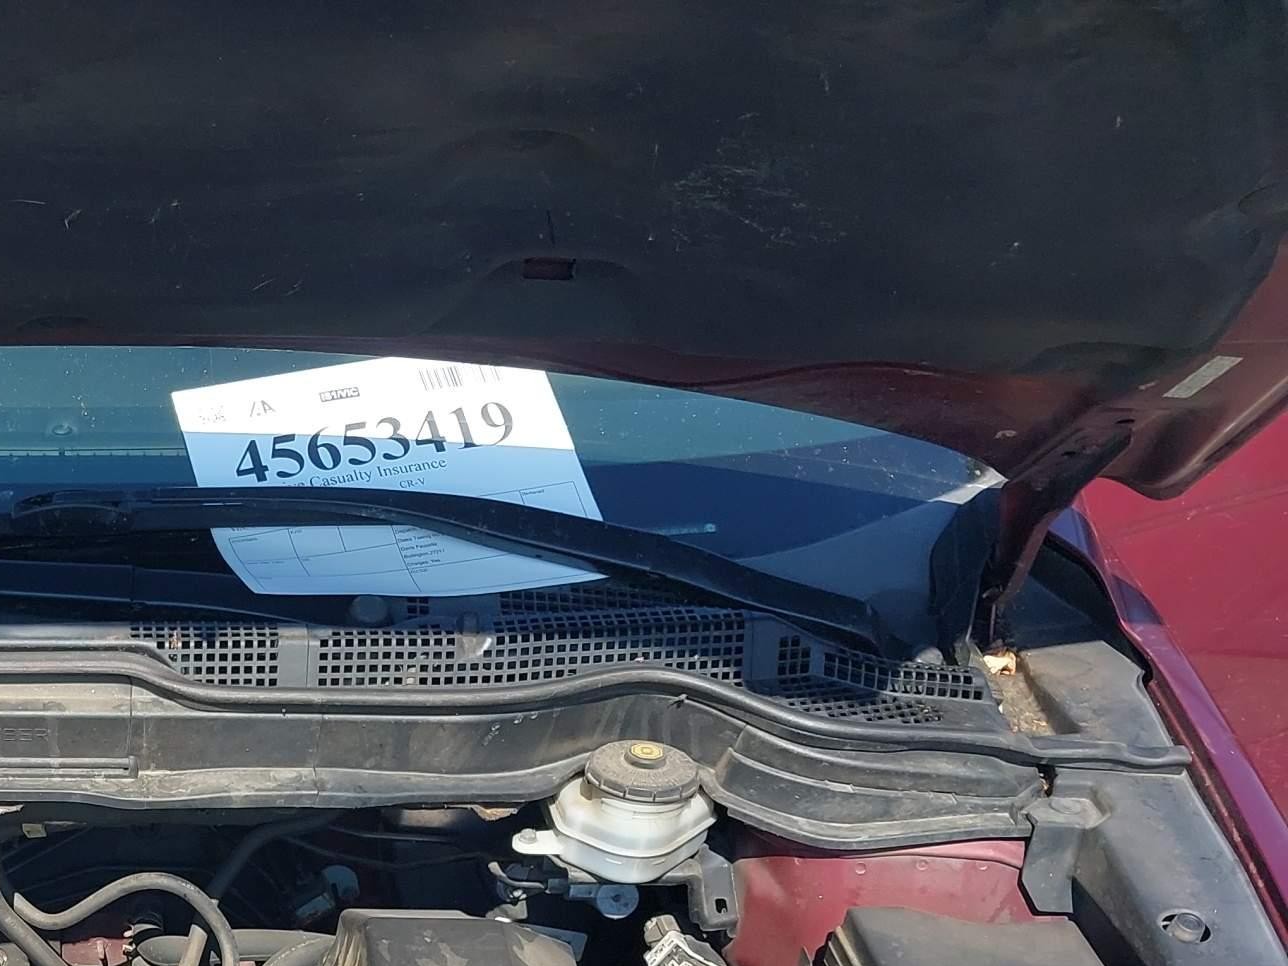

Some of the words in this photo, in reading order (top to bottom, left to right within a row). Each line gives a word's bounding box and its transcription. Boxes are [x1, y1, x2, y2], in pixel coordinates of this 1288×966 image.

[235, 401, 514, 483] 45653419
[309, 468, 372, 487] Casualty
[377, 457, 448, 477] Insurance
[399, 477, 426, 489] CR-V
